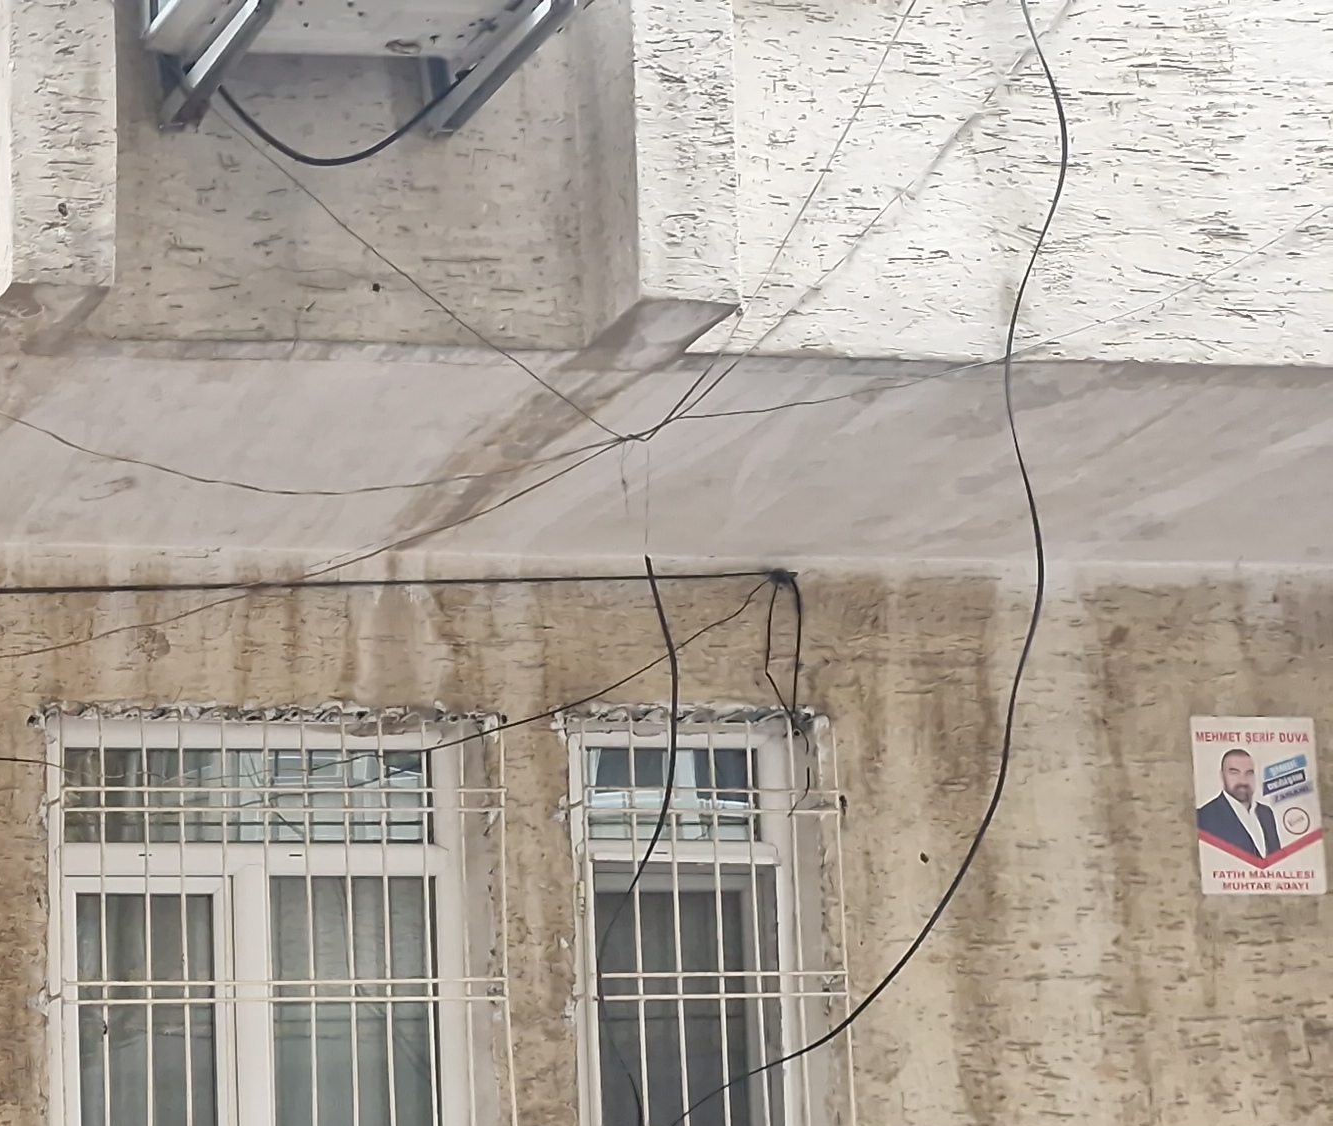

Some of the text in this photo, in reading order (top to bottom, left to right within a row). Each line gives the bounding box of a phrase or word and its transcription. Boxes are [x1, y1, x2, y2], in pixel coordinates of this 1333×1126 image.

[1195, 730, 1309, 744] MEHMET ŞERİF DUVA
[1222, 882, 1309, 891] MUHTAR ADAYI
